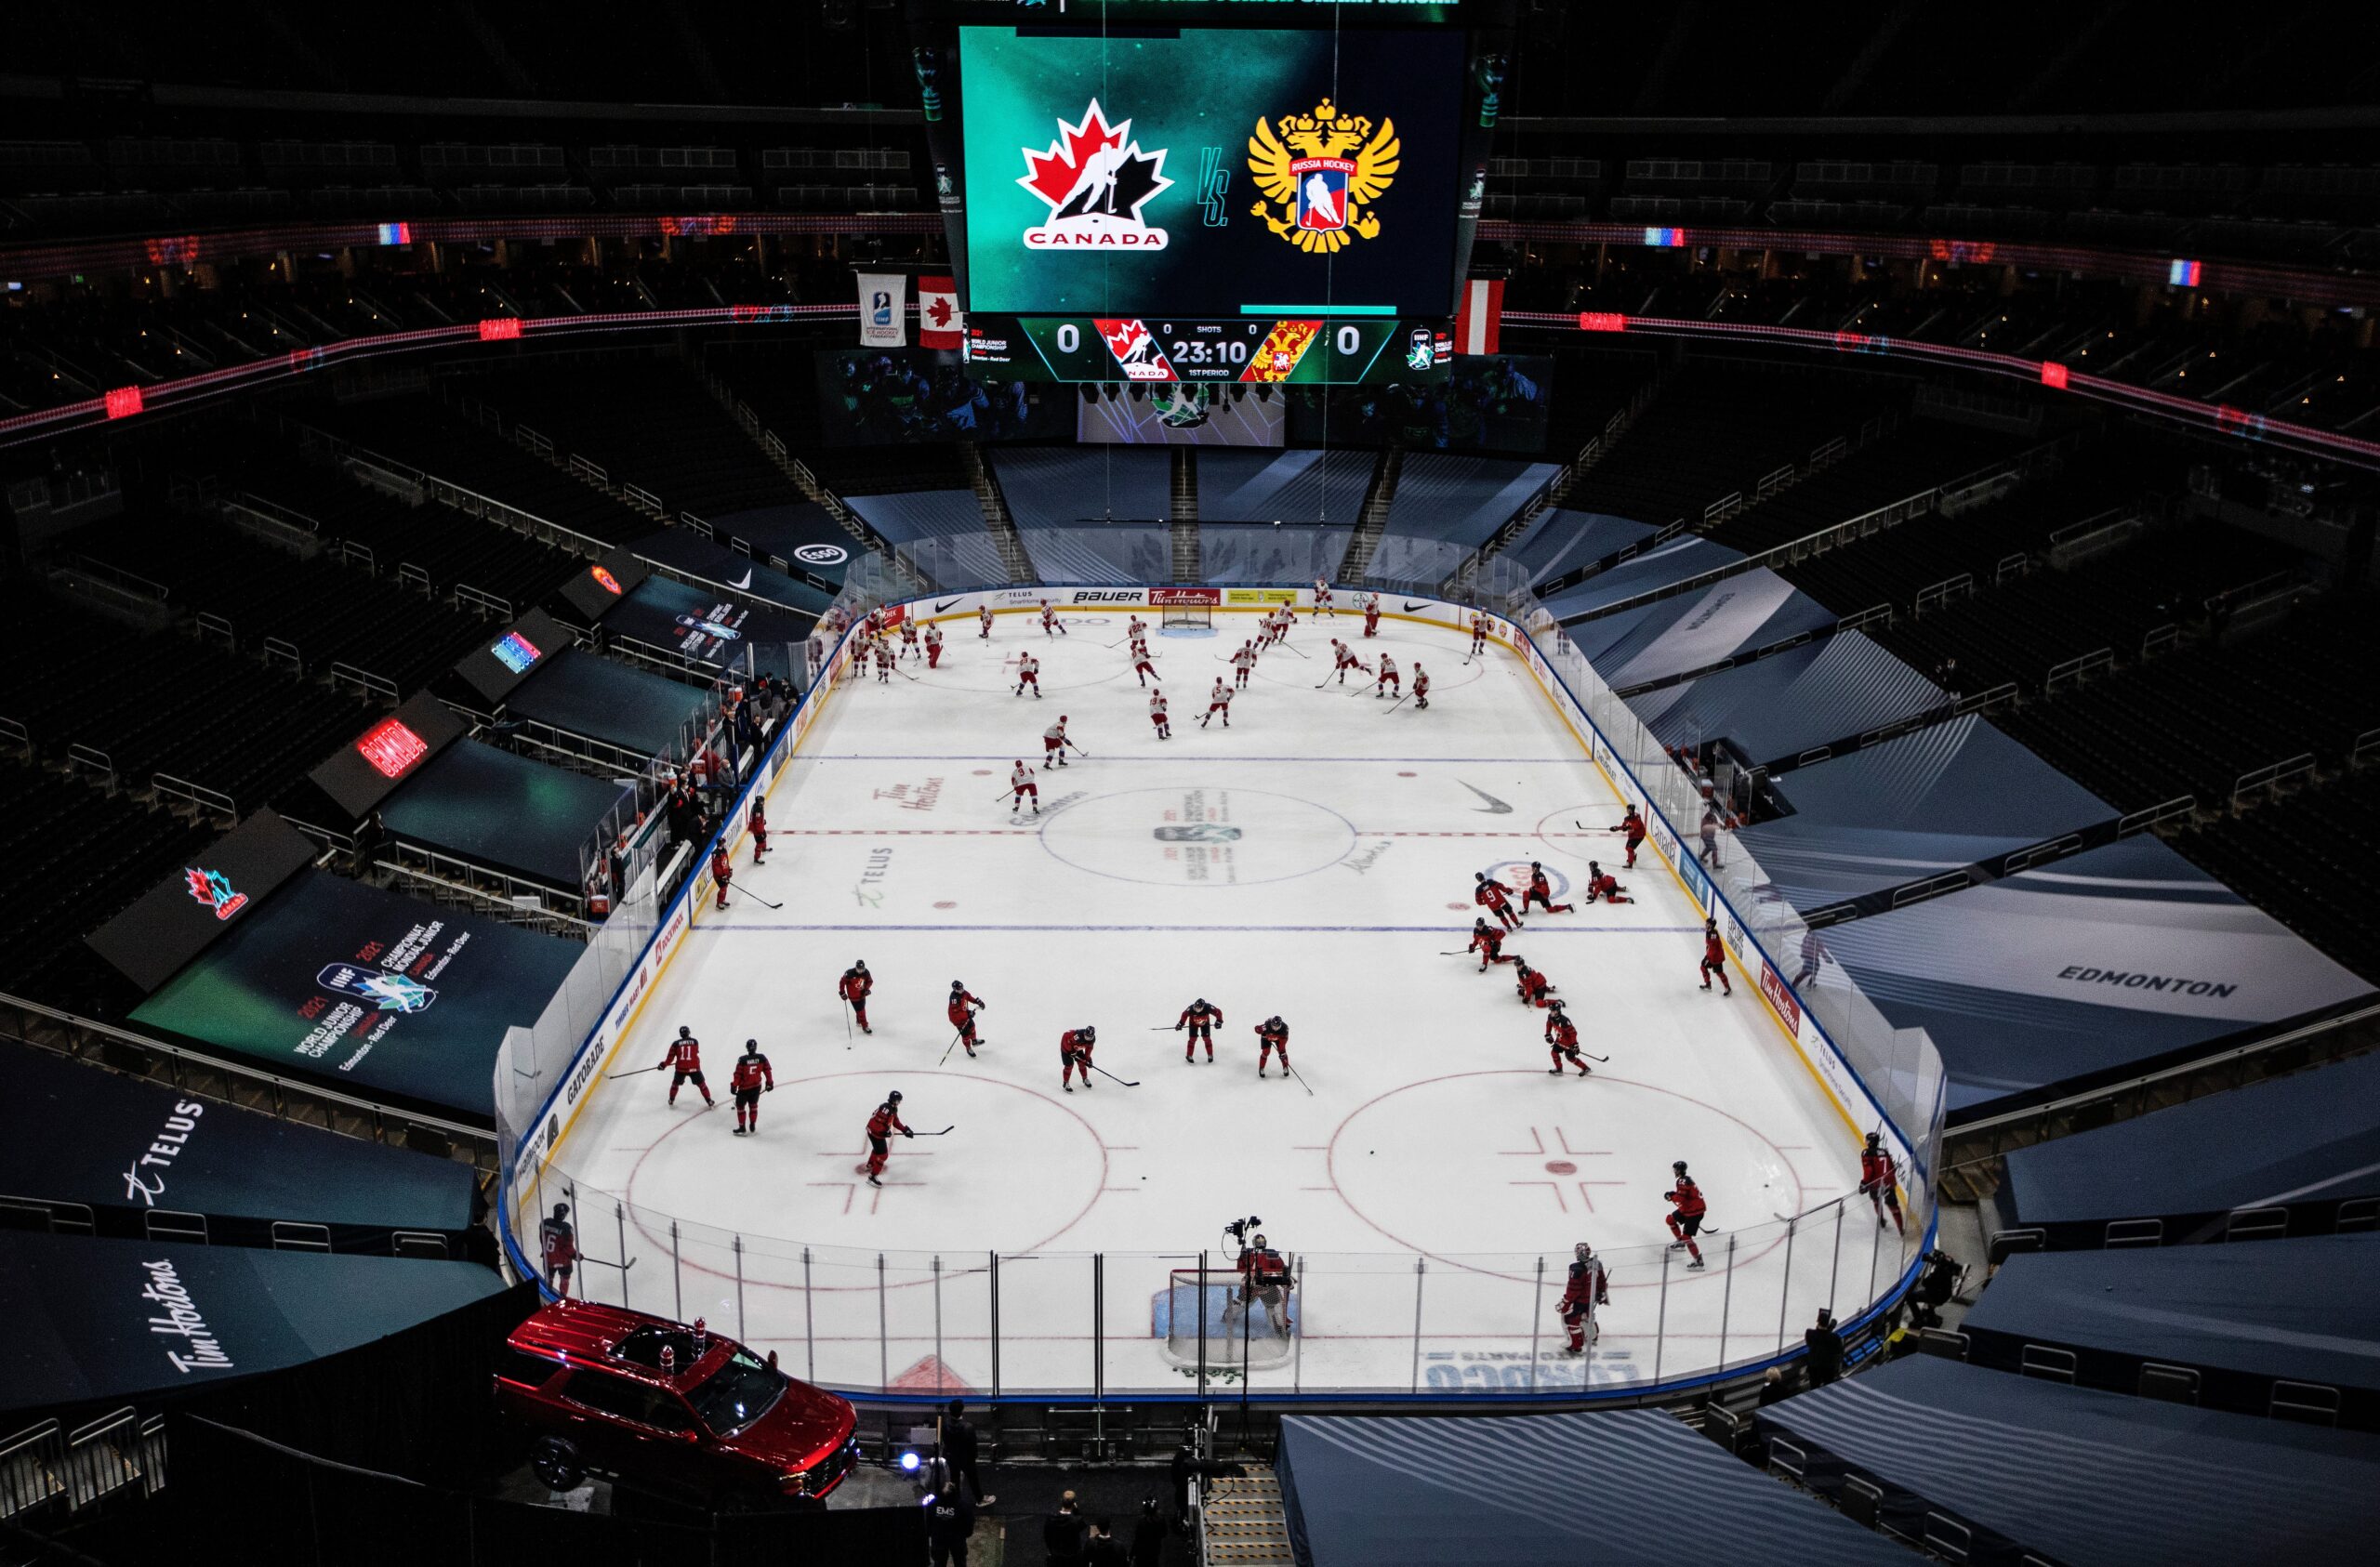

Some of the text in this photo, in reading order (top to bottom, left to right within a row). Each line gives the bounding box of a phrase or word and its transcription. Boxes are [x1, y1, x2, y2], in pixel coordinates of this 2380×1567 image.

[1292, 159, 1355, 172] RUSSIA HOCKEY
[1029, 232, 1161, 245] CANADA
[480, 318, 521, 341] CANADA
[1163, 323, 1257, 335] 0 SHOTS 0
[1580, 312, 1624, 331] CANADA
[1057, 323, 1080, 353] 0
[1172, 341, 1247, 363] 23:10
[1337, 326, 1360, 355] 0
[362, 721, 428, 777] CANADA
[1650, 811, 1676, 865] Canada
[861, 847, 892, 885] TELUS
[1486, 889, 1497, 902] 9
[661, 911, 684, 949] ROCKWOOL
[1727, 915, 1745, 945] EXPLORE
[381, 923, 426, 968] CHAMPIONNAT
[392, 920, 444, 972] MONDIAL JUNIOR
[330, 967, 356, 988] IIHF
[2056, 965, 2238, 998] EDMONTON
[1761, 968, 1799, 1034] Tim Hortons
[294, 1002, 353, 1054] WORLD JUNIOR
[308, 1006, 364, 1058] CHAMPIONSHIP
[680, 1046, 693, 1060] 11
[1819, 1043, 1836, 1071] TELUS
[567, 1034, 604, 1106] GATORADE
[140, 1099, 204, 1167] TELUS
[1878, 1156, 1887, 1175] 7
[546, 1234, 556, 1253] 6
[142, 1258, 234, 1374] Tim Hortons
[936, 1506, 955, 1516] EMS
